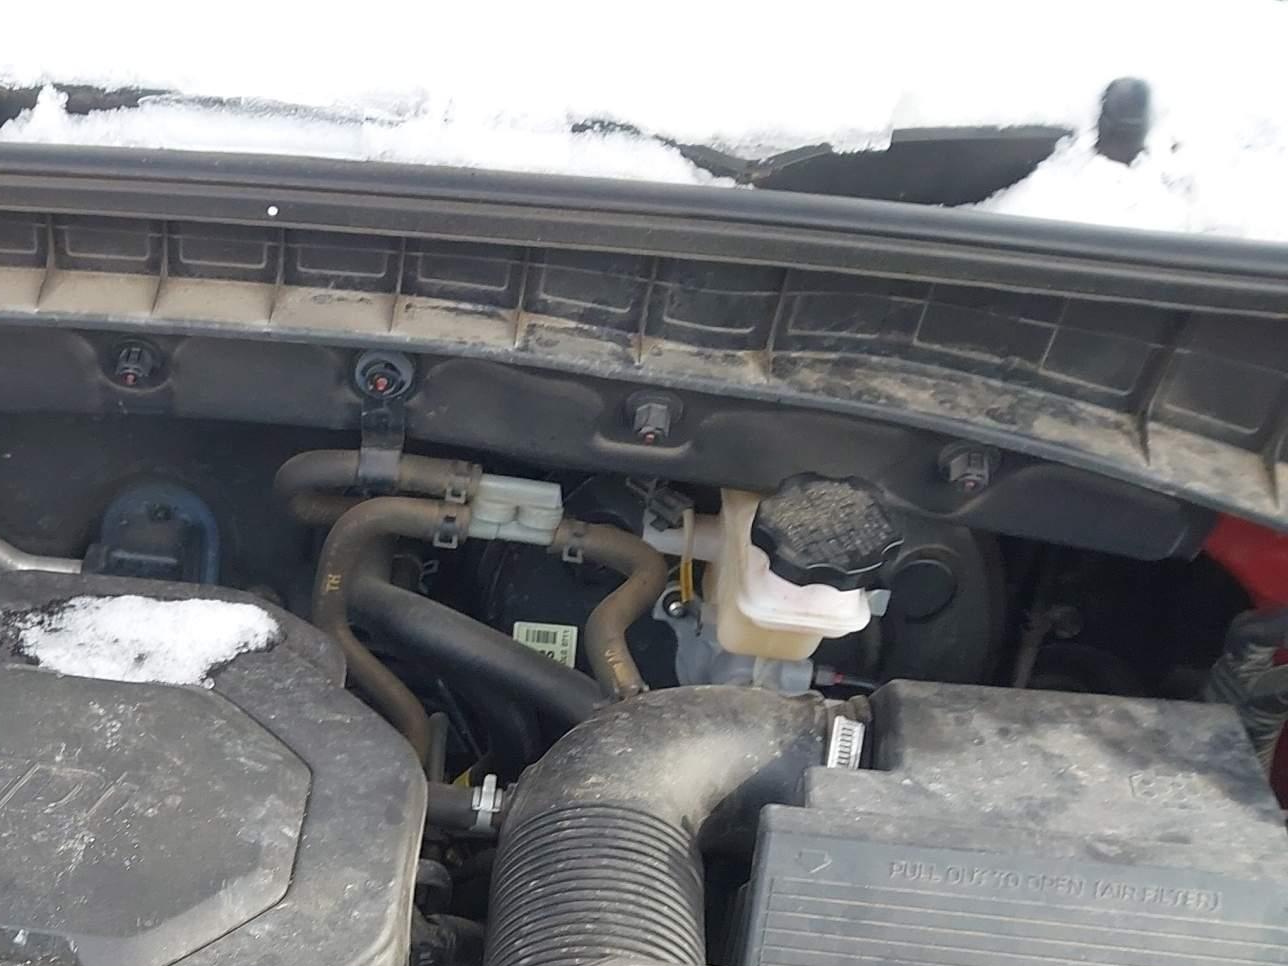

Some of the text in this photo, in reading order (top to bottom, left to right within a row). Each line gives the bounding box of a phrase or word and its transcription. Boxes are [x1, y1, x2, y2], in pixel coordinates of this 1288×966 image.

[888, 859, 942, 883] PULL
[993, 868, 1023, 890] TO
[1027, 872, 1086, 899] OPEN
[1141, 885, 1224, 913] FILTER)
